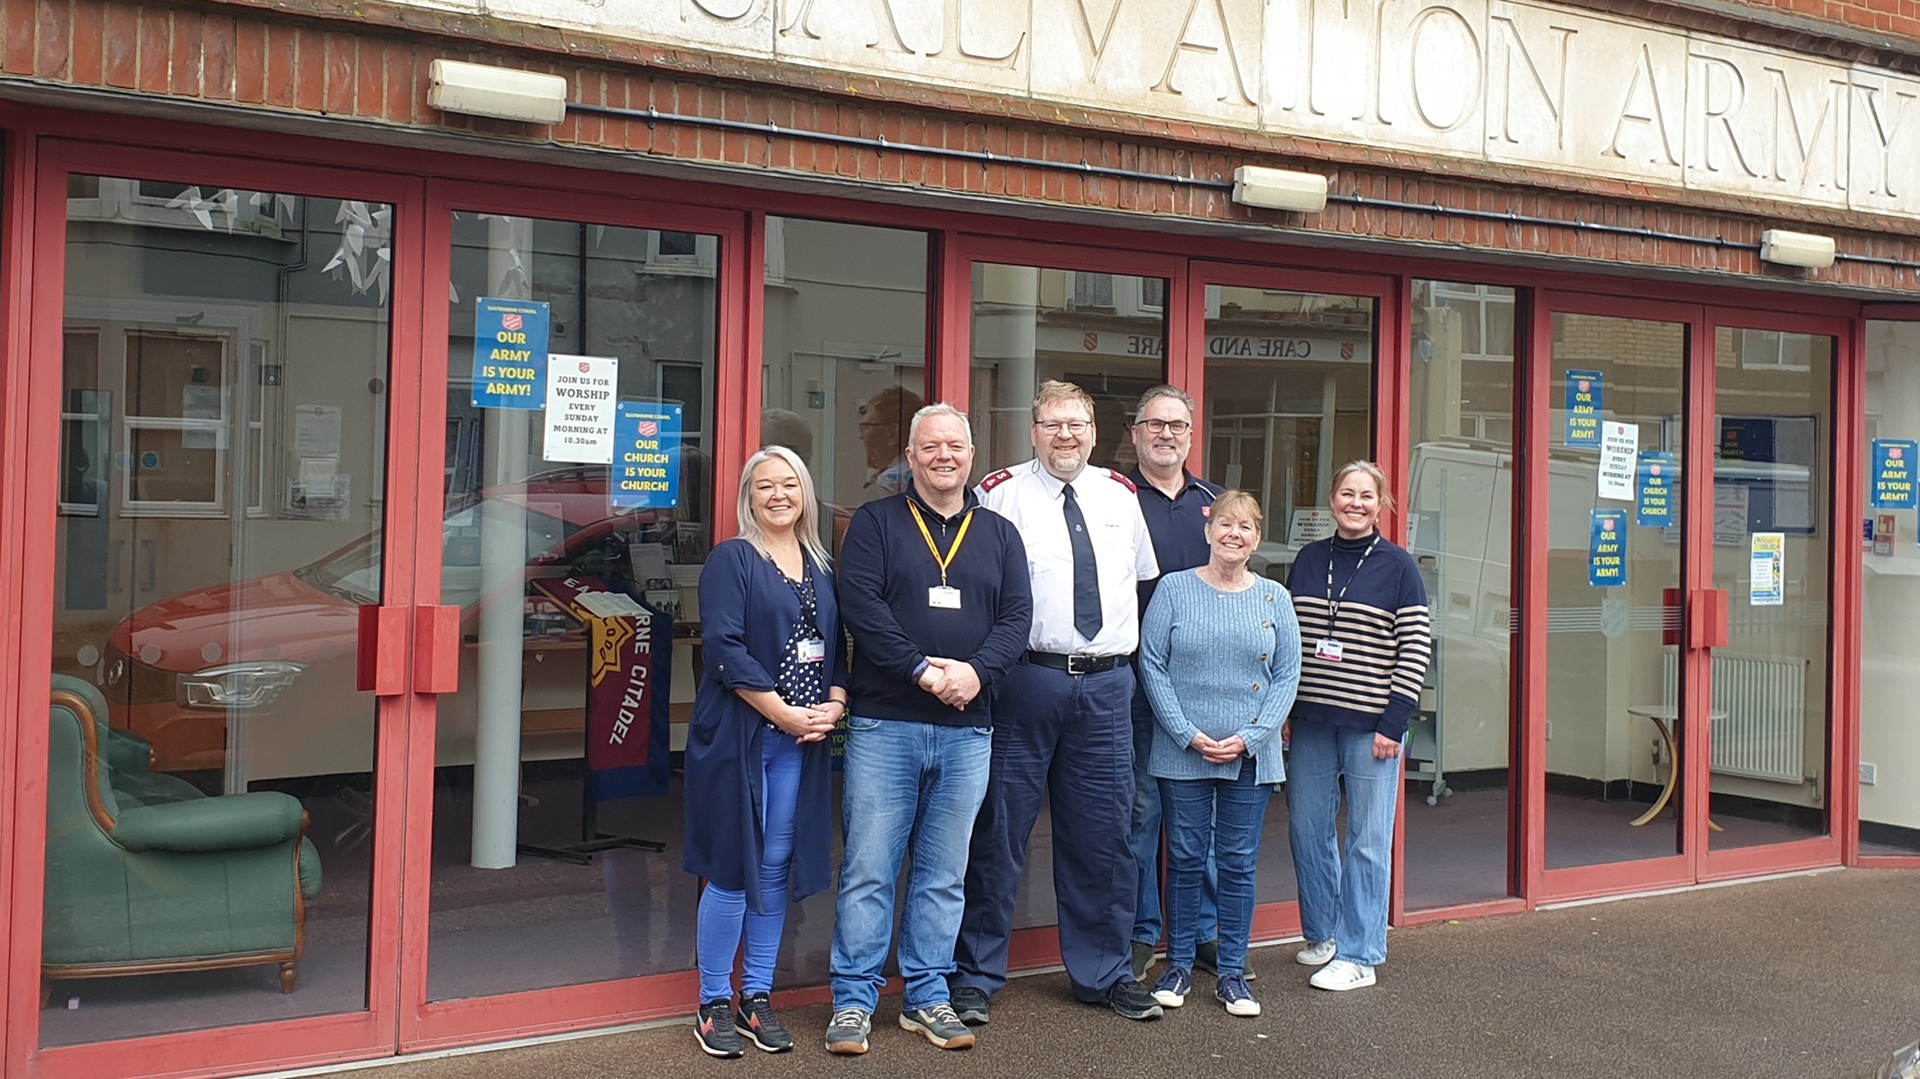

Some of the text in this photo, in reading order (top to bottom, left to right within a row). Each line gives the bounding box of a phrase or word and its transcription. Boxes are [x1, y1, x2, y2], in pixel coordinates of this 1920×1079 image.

[680, 0, 1918, 198] VATION ARMY
[496, 331, 527, 345] OUR
[490, 348, 531, 362] ARMY
[482, 365, 536, 380] IS YOUR
[557, 376, 610, 387] JOIN US FOR
[485, 382, 531, 397] ARMY!
[555, 387, 610, 401] WORSHIP
[1576, 392, 1592, 402] OUR
[568, 402, 597, 412] EVERY
[1573, 405, 1595, 415] ARMY
[564, 413, 600, 423] SUNDAY
[1569, 417, 1597, 428] IS YOUR
[553, 424, 609, 435] MORNING AT
[564, 437, 598, 445] 10.30am
[635, 439, 659, 450] OUR
[624, 452, 669, 464] CHURCH
[1885, 458, 1905, 468] OUR
[625, 467, 667, 478] IS YOUR
[1881, 470, 1908, 480] ARMY
[620, 480, 670, 492] CHURCH!
[1877, 481, 1911, 491] IS YOUR
[1879, 491, 1909, 502] ARMY!
[1600, 531, 1617, 541] OUR
[1597, 544, 1619, 553] ARMY
[1593, 556, 1621, 566] IS YOUR
[609, 664, 648, 745] CITADEL
